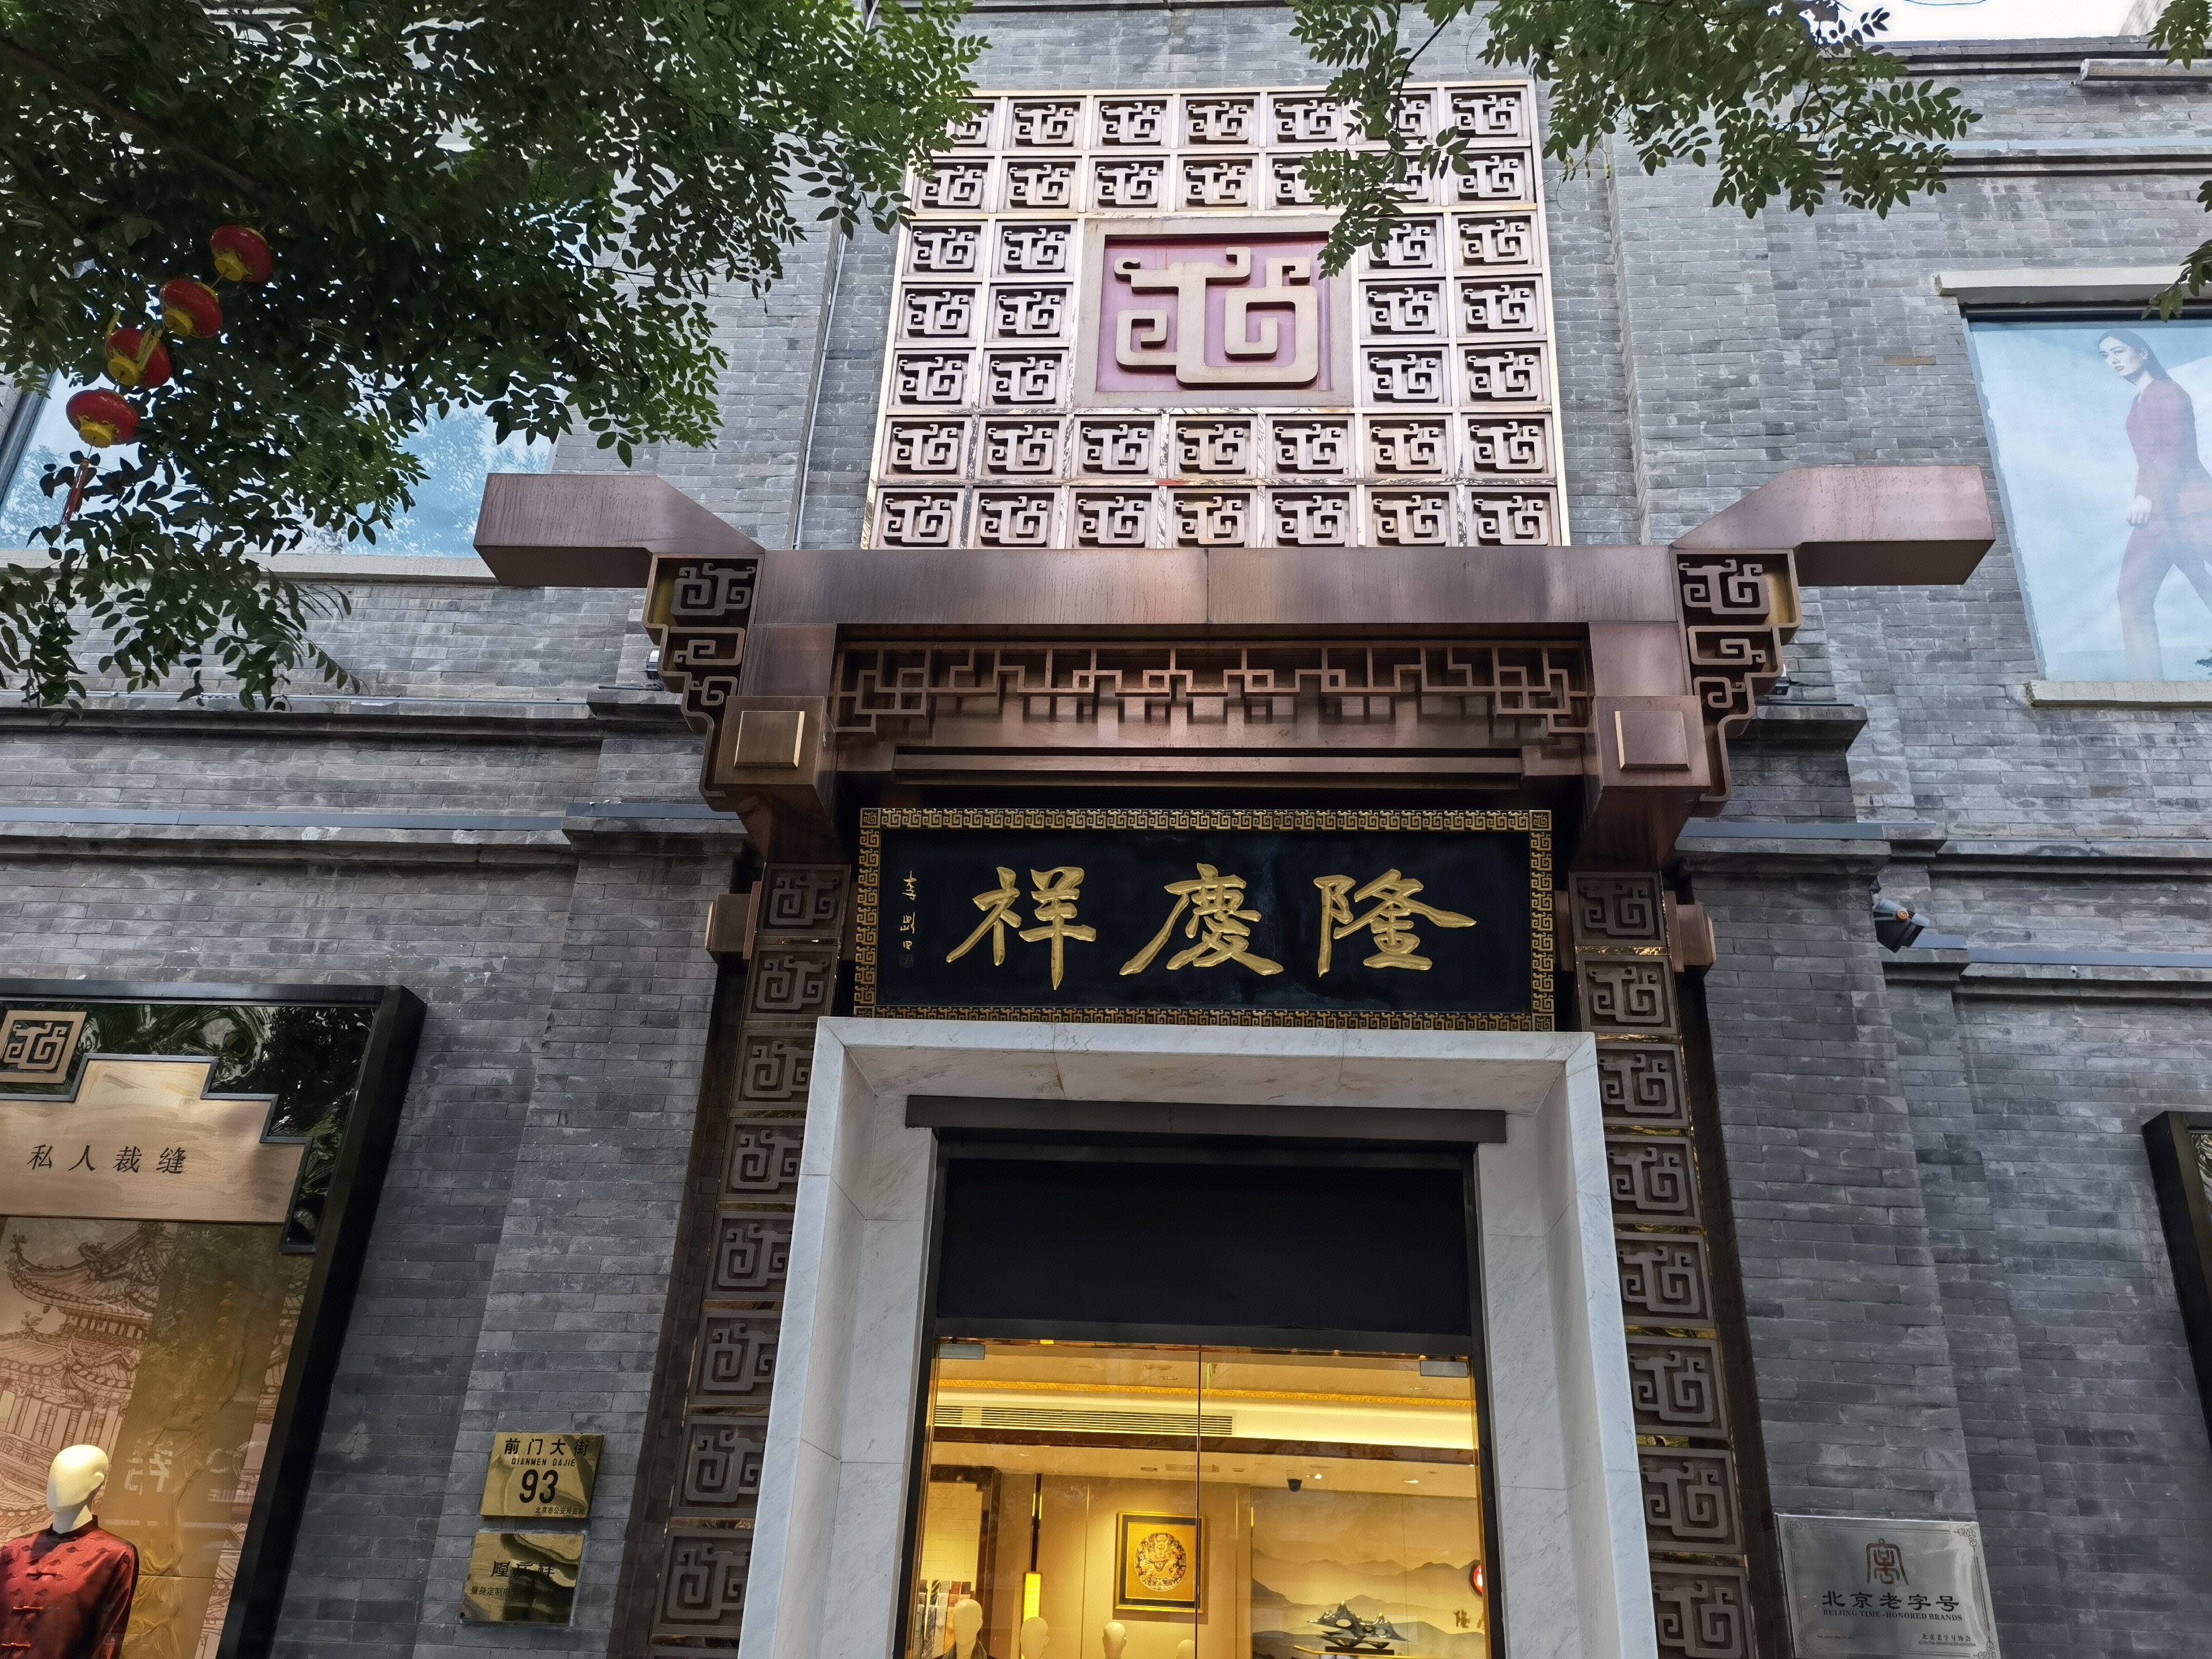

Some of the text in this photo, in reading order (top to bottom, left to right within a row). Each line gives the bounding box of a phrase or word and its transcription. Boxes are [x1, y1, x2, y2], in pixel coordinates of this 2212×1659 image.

[27, 1143, 187, 1175] 私人裁缝
[504, 1438, 589, 1456] 前门大街
[511, 1458, 576, 1467] QIANMEN DAJIE
[519, 1469, 558, 1503] 93
[1822, 1590, 1960, 1612] 北京老字号
[1823, 1609, 1858, 1617] BEIJING
[1859, 1610, 1927, 1620] TIME-HONORED
